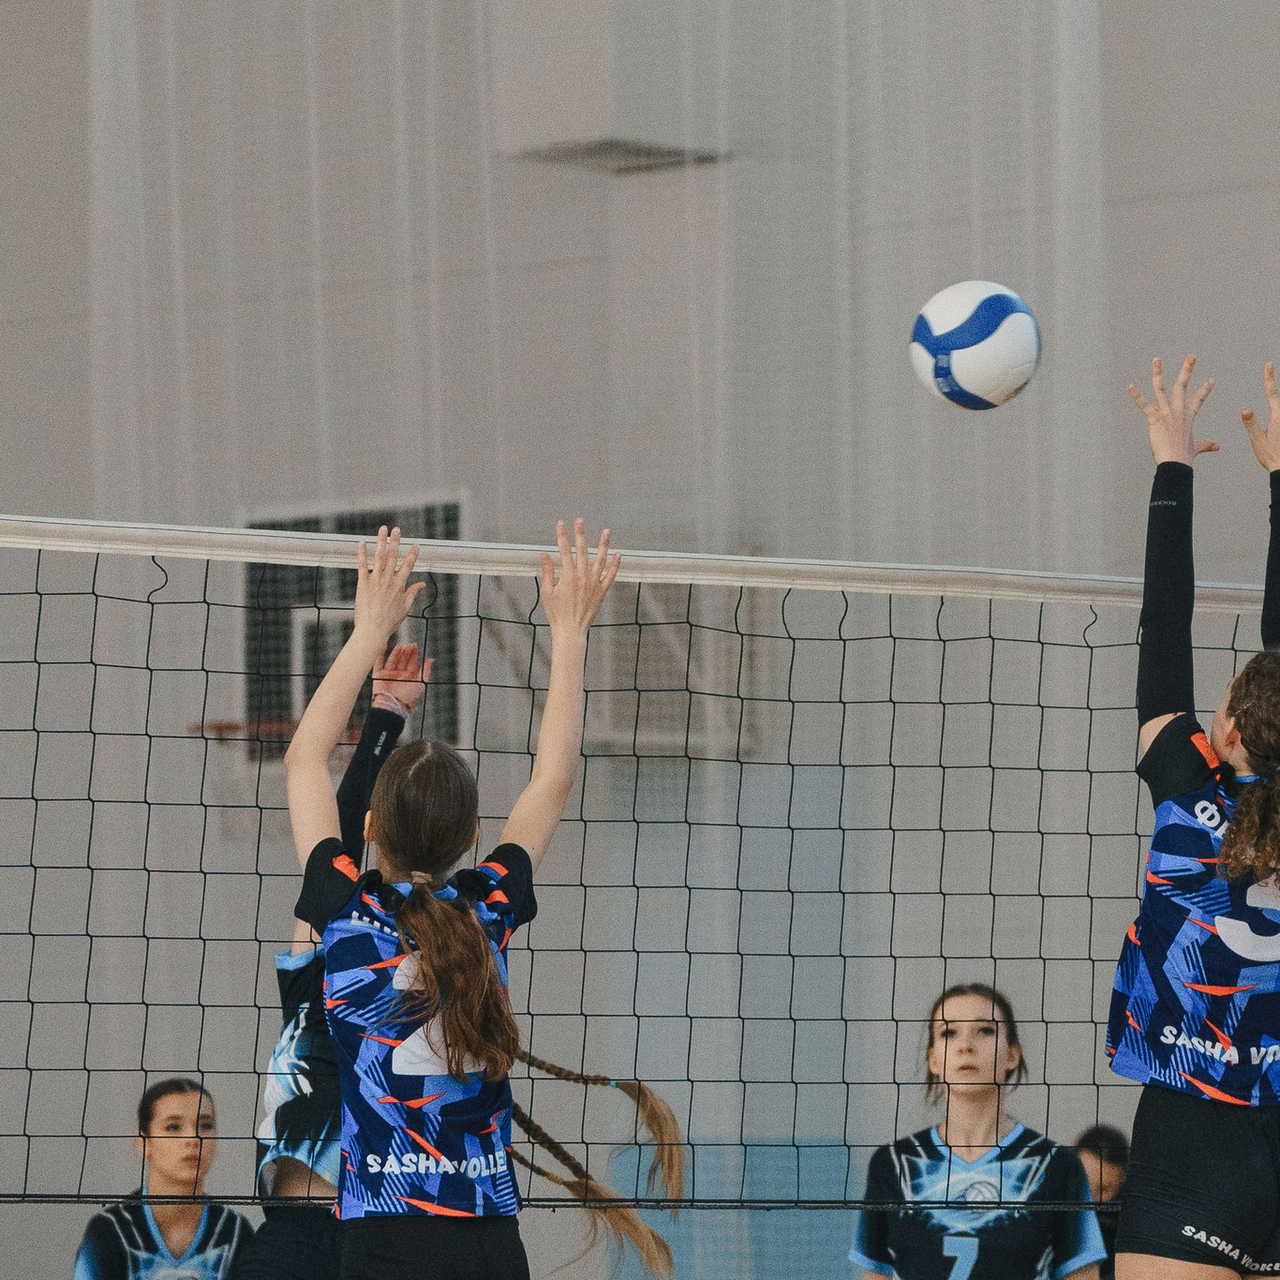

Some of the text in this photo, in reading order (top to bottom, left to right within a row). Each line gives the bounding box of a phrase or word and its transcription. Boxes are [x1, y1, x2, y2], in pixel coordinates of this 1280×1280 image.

[1160, 1025, 1239, 1065] SASHA
[366, 1153, 455, 1175] SASHA
[1182, 1225, 1241, 1260] SASHA
